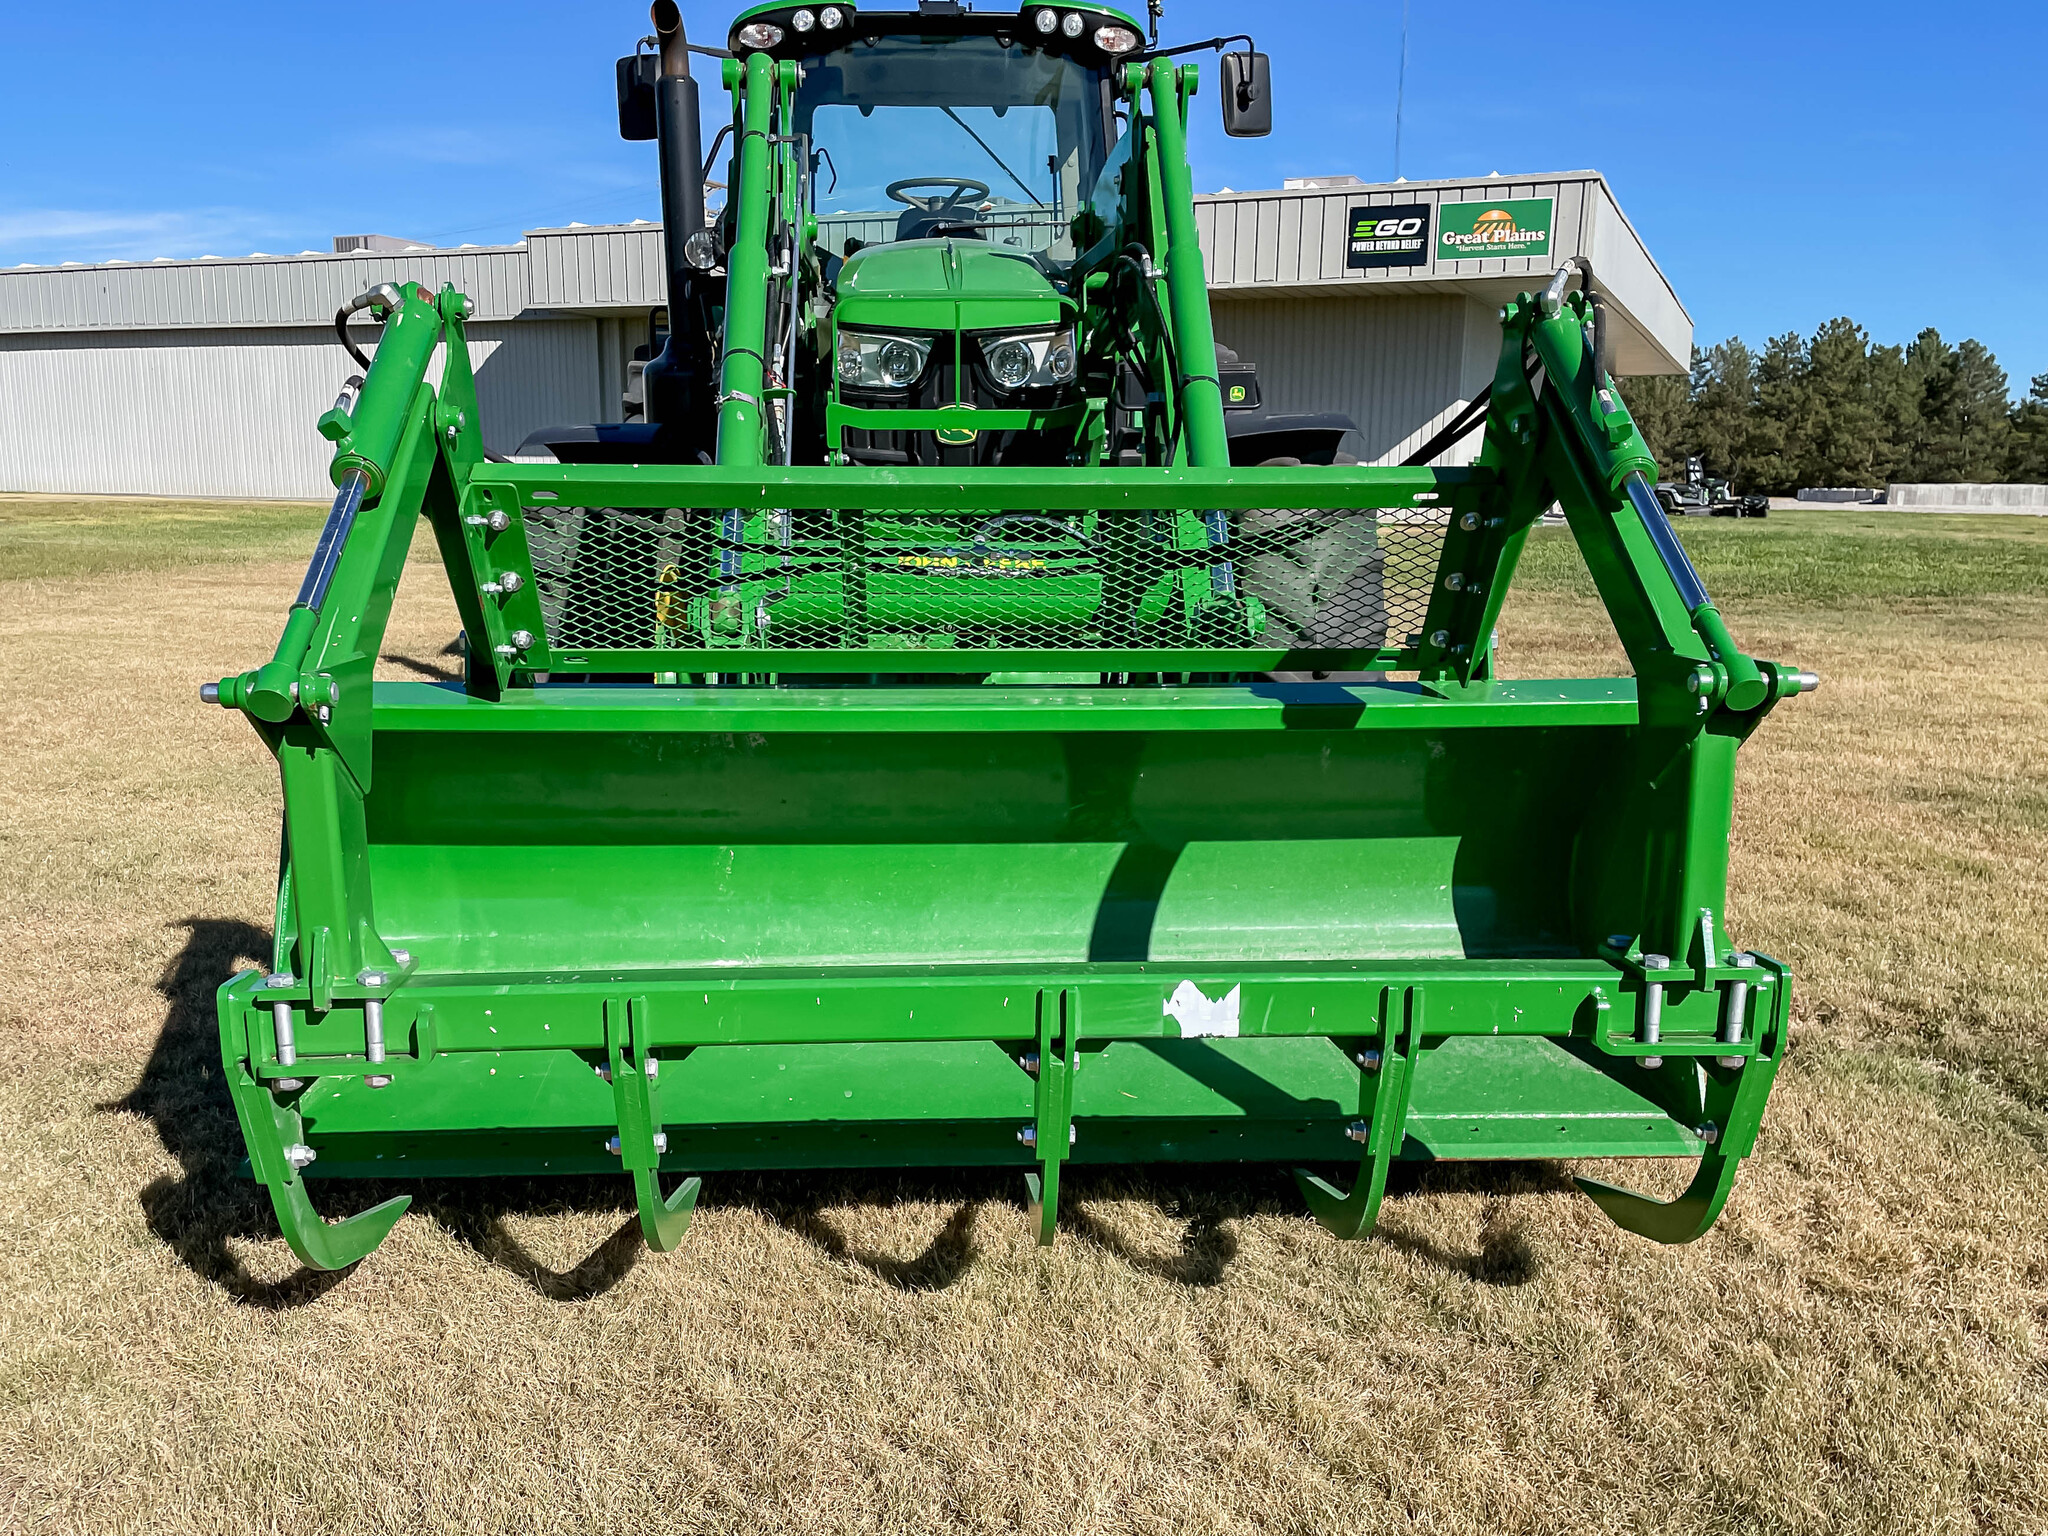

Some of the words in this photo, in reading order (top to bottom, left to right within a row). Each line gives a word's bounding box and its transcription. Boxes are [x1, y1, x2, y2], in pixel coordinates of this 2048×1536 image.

[1353, 218, 1422, 238] EGO
[1442, 231, 1490, 245] Great
[1494, 228, 1546, 243] Plains
[1351, 241, 1375, 252] POWER
[1401, 239, 1422, 250] BELIEF
[1486, 243, 1507, 251] Starts
